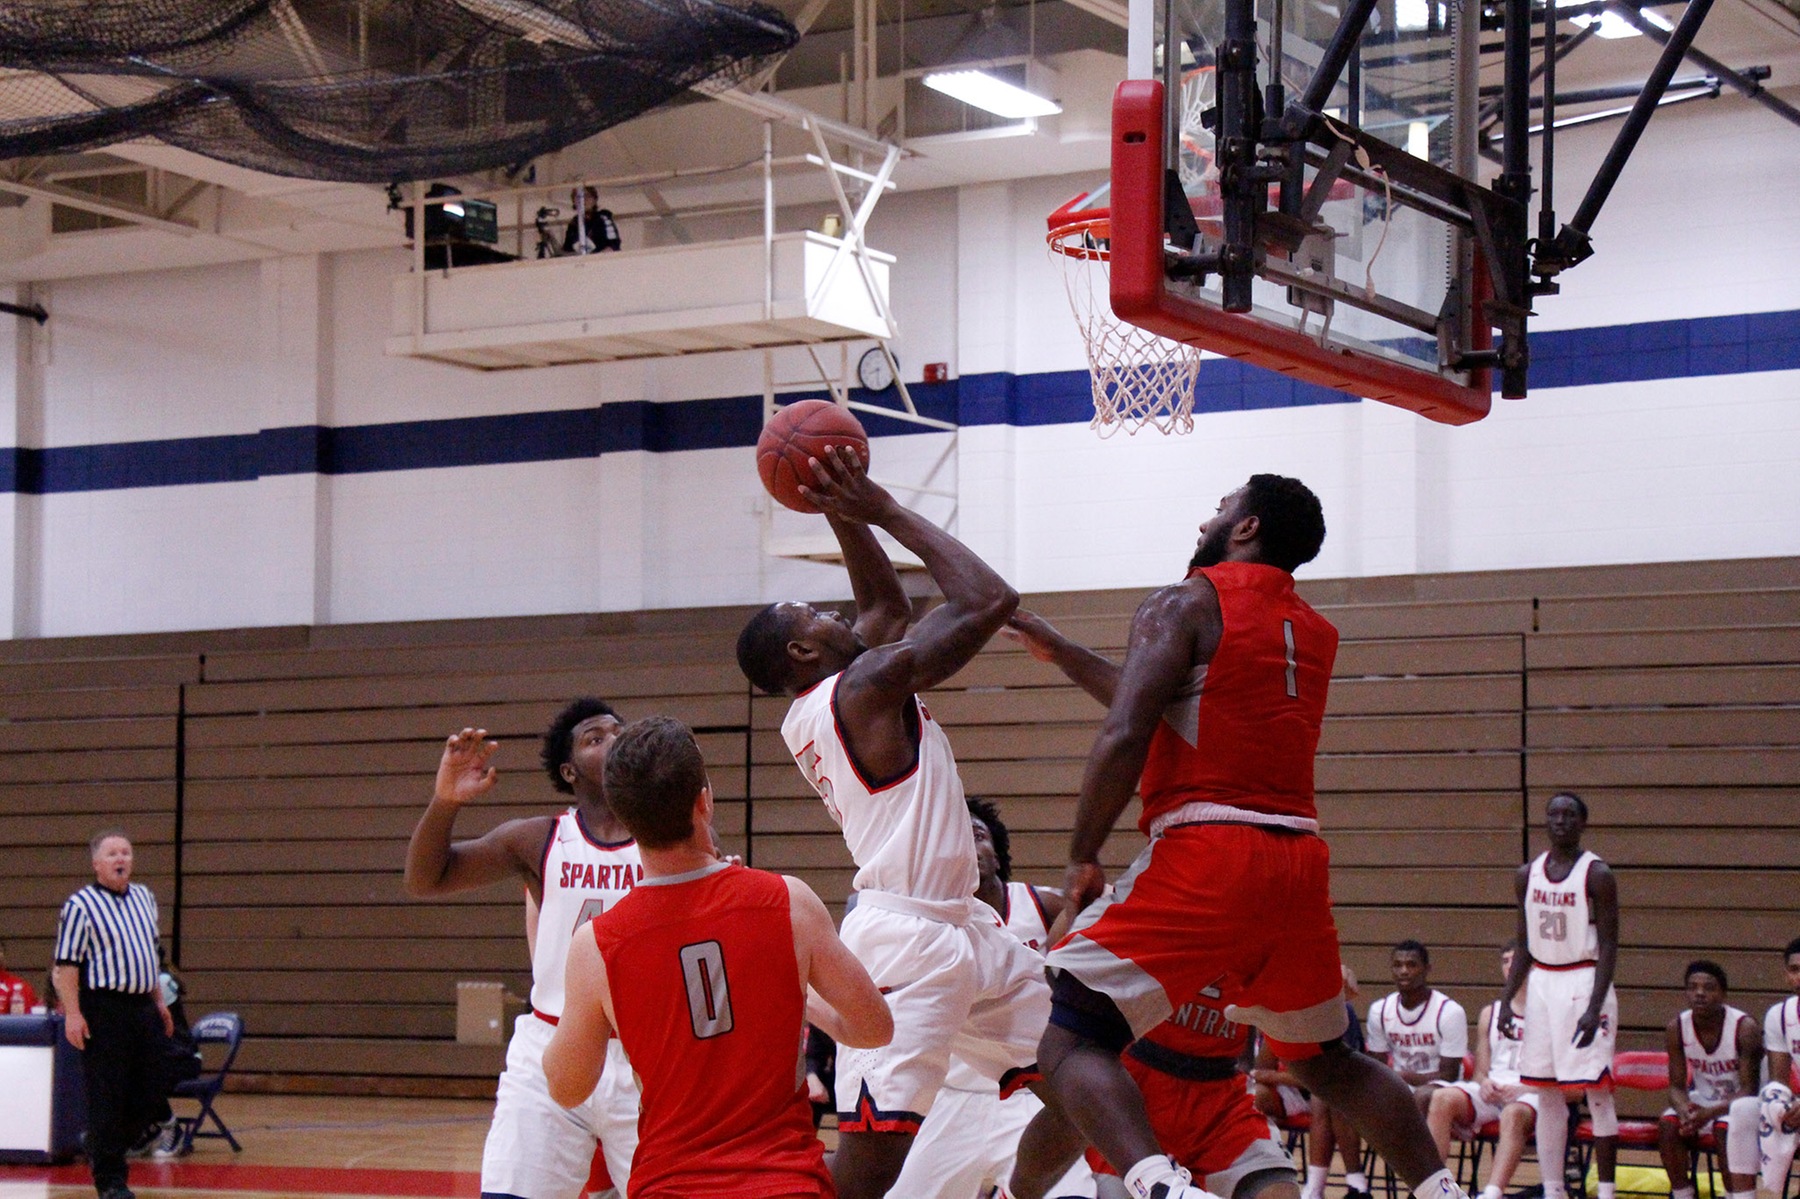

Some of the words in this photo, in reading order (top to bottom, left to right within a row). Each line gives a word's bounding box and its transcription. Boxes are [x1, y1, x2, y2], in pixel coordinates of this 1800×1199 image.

[1283, 618, 1298, 699] 1
[1532, 888, 1577, 907] SPARTANS
[1539, 910, 1567, 942] 20
[678, 939, 734, 1040] 0
